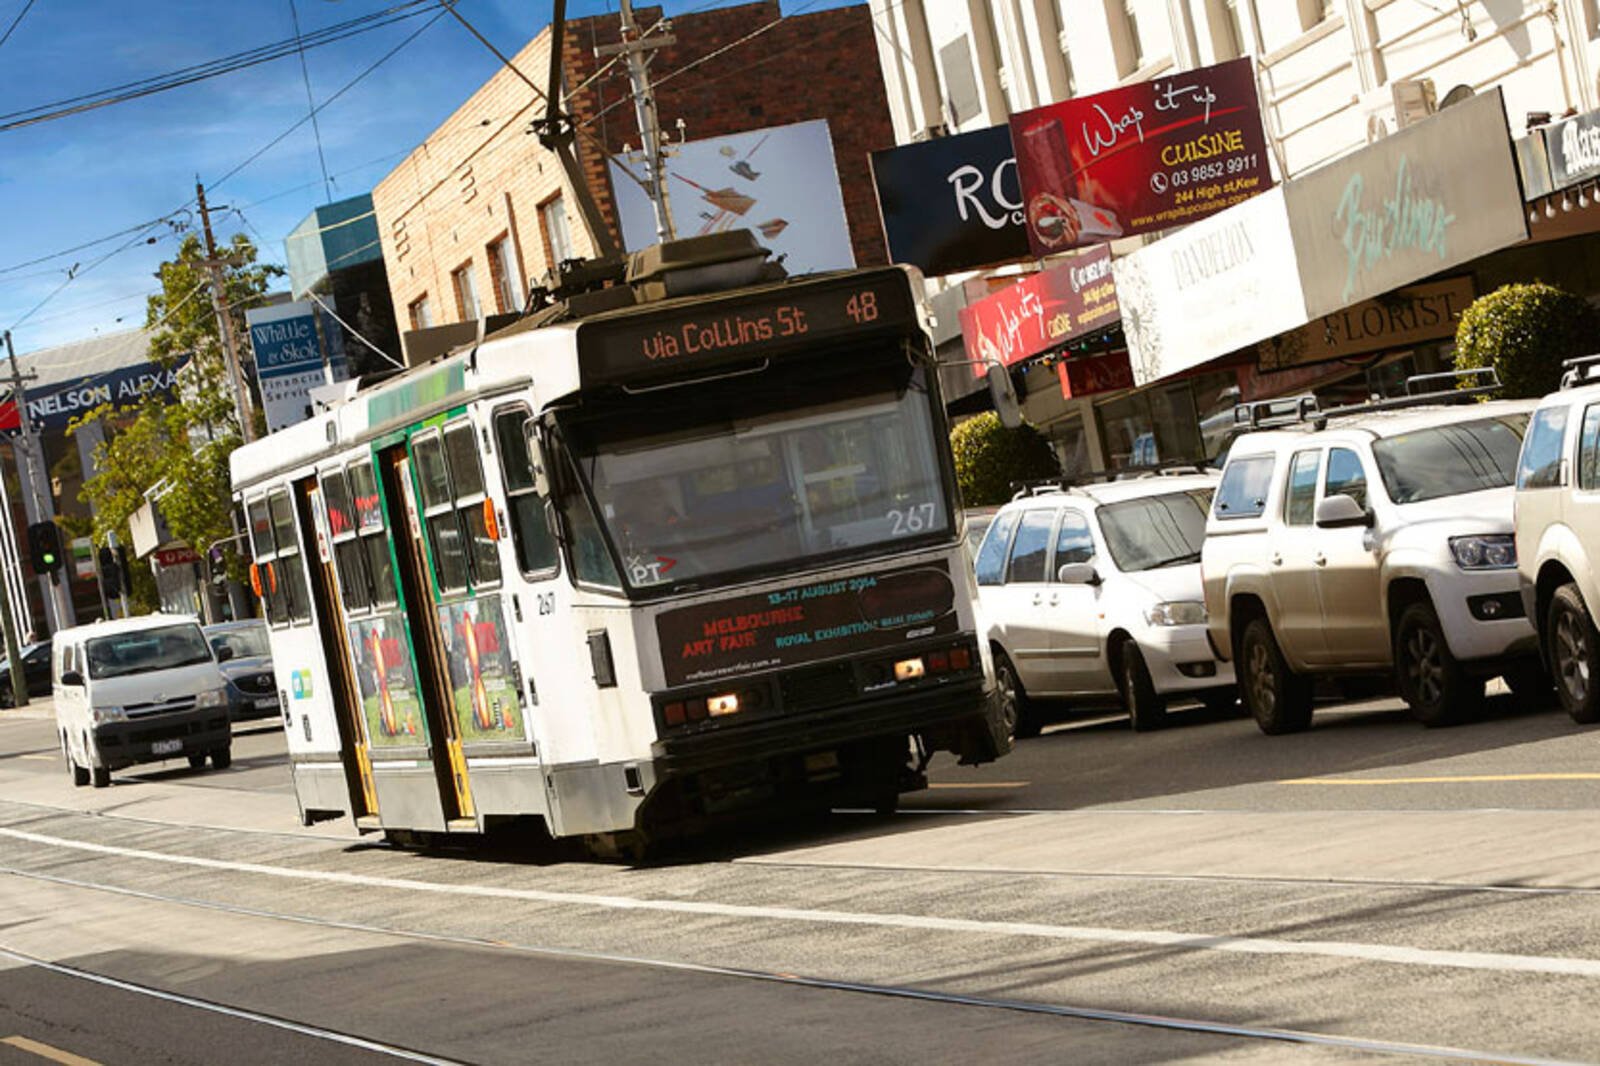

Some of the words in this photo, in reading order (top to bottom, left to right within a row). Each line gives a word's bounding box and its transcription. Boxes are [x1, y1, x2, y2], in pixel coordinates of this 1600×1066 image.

[1083, 103, 1144, 156] Wrap
[1155, 83, 1201, 111] it
[1192, 89, 1217, 124] up
[1161, 130, 1244, 166] CUISINE
[1171, 170, 1188, 187] 03
[1191, 161, 1224, 182] 9852
[1226, 153, 1258, 174] 9911
[1196, 184, 1222, 200] High
[776, 306, 808, 336] St
[846, 291, 878, 323] 48
[1324, 290, 1458, 346] FLORIST
[29, 385, 112, 418] NELSON
[118, 370, 178, 399] ALEXA
[886, 503, 937, 535] 267
[801, 582, 847, 600] AUGUST
[703, 605, 806, 637] MELBOURNE
[682, 640, 715, 658] ART
[720, 631, 757, 651] FAIR
[775, 632, 812, 648] ROYAL
